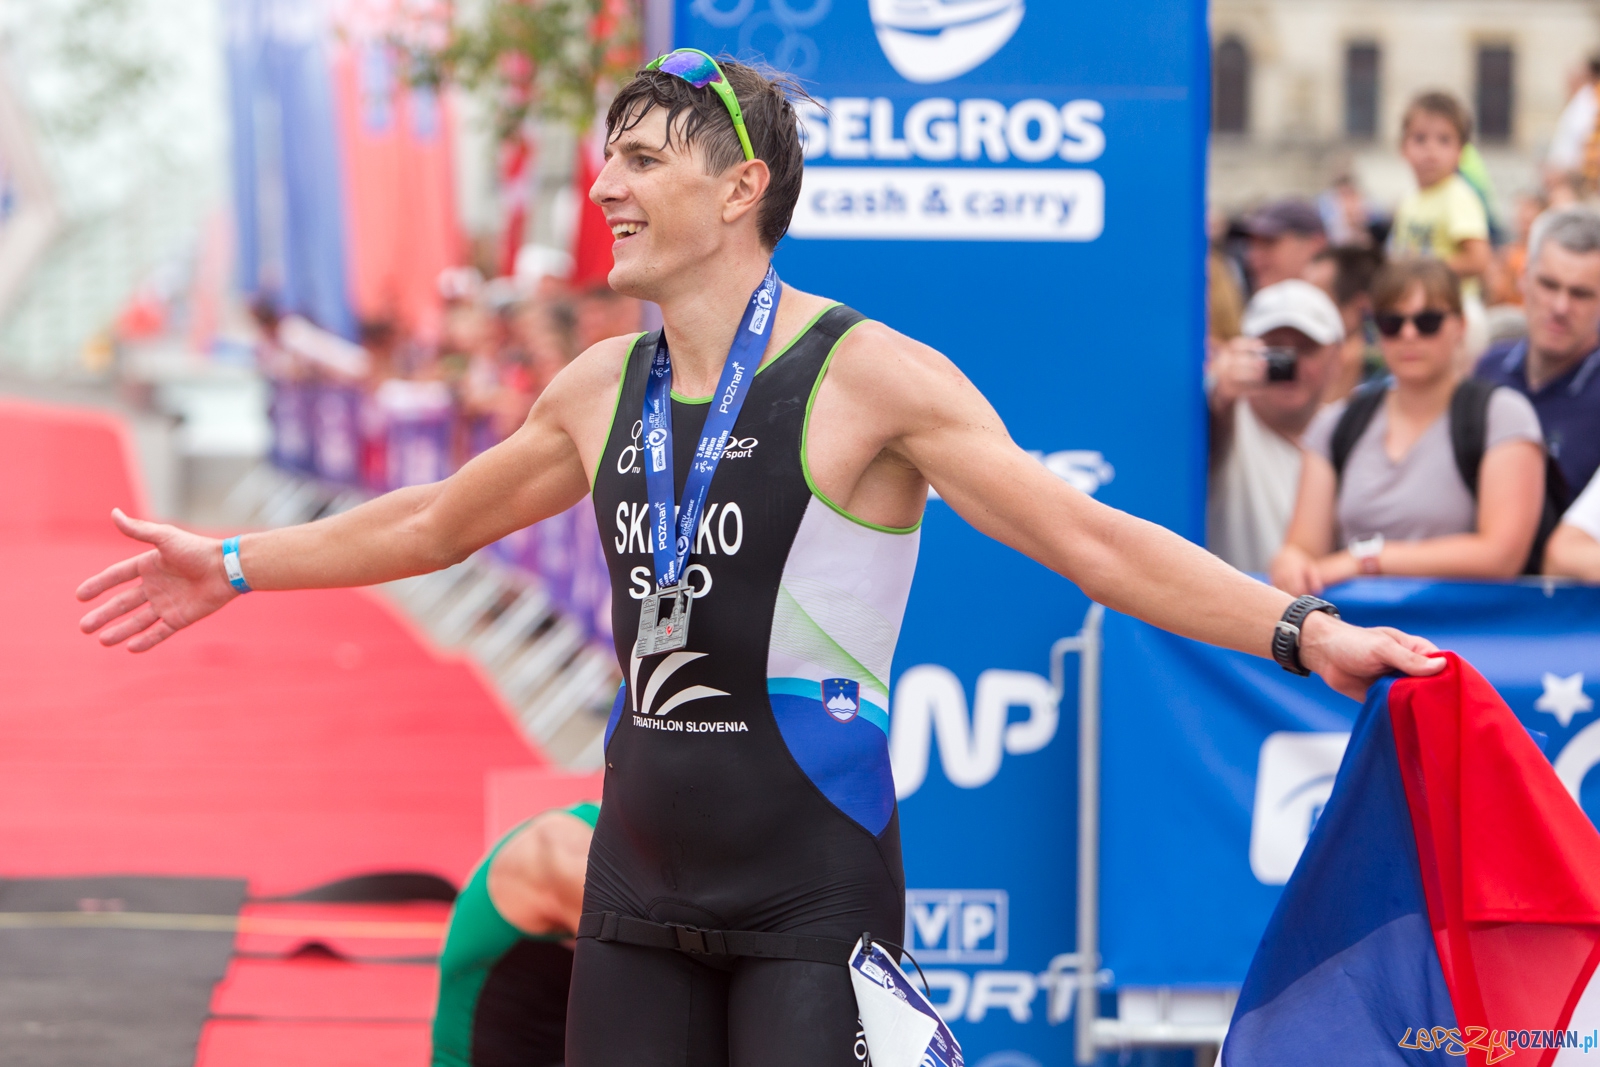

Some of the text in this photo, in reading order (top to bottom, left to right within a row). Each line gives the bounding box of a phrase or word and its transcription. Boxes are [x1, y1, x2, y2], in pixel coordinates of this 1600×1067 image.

[797, 97, 1106, 163] SELGROS
[810, 181, 1078, 228] cash & carry
[615, 501, 743, 556] SKKO
[632, 715, 749, 733] TRIATHLON SLOVENIA
